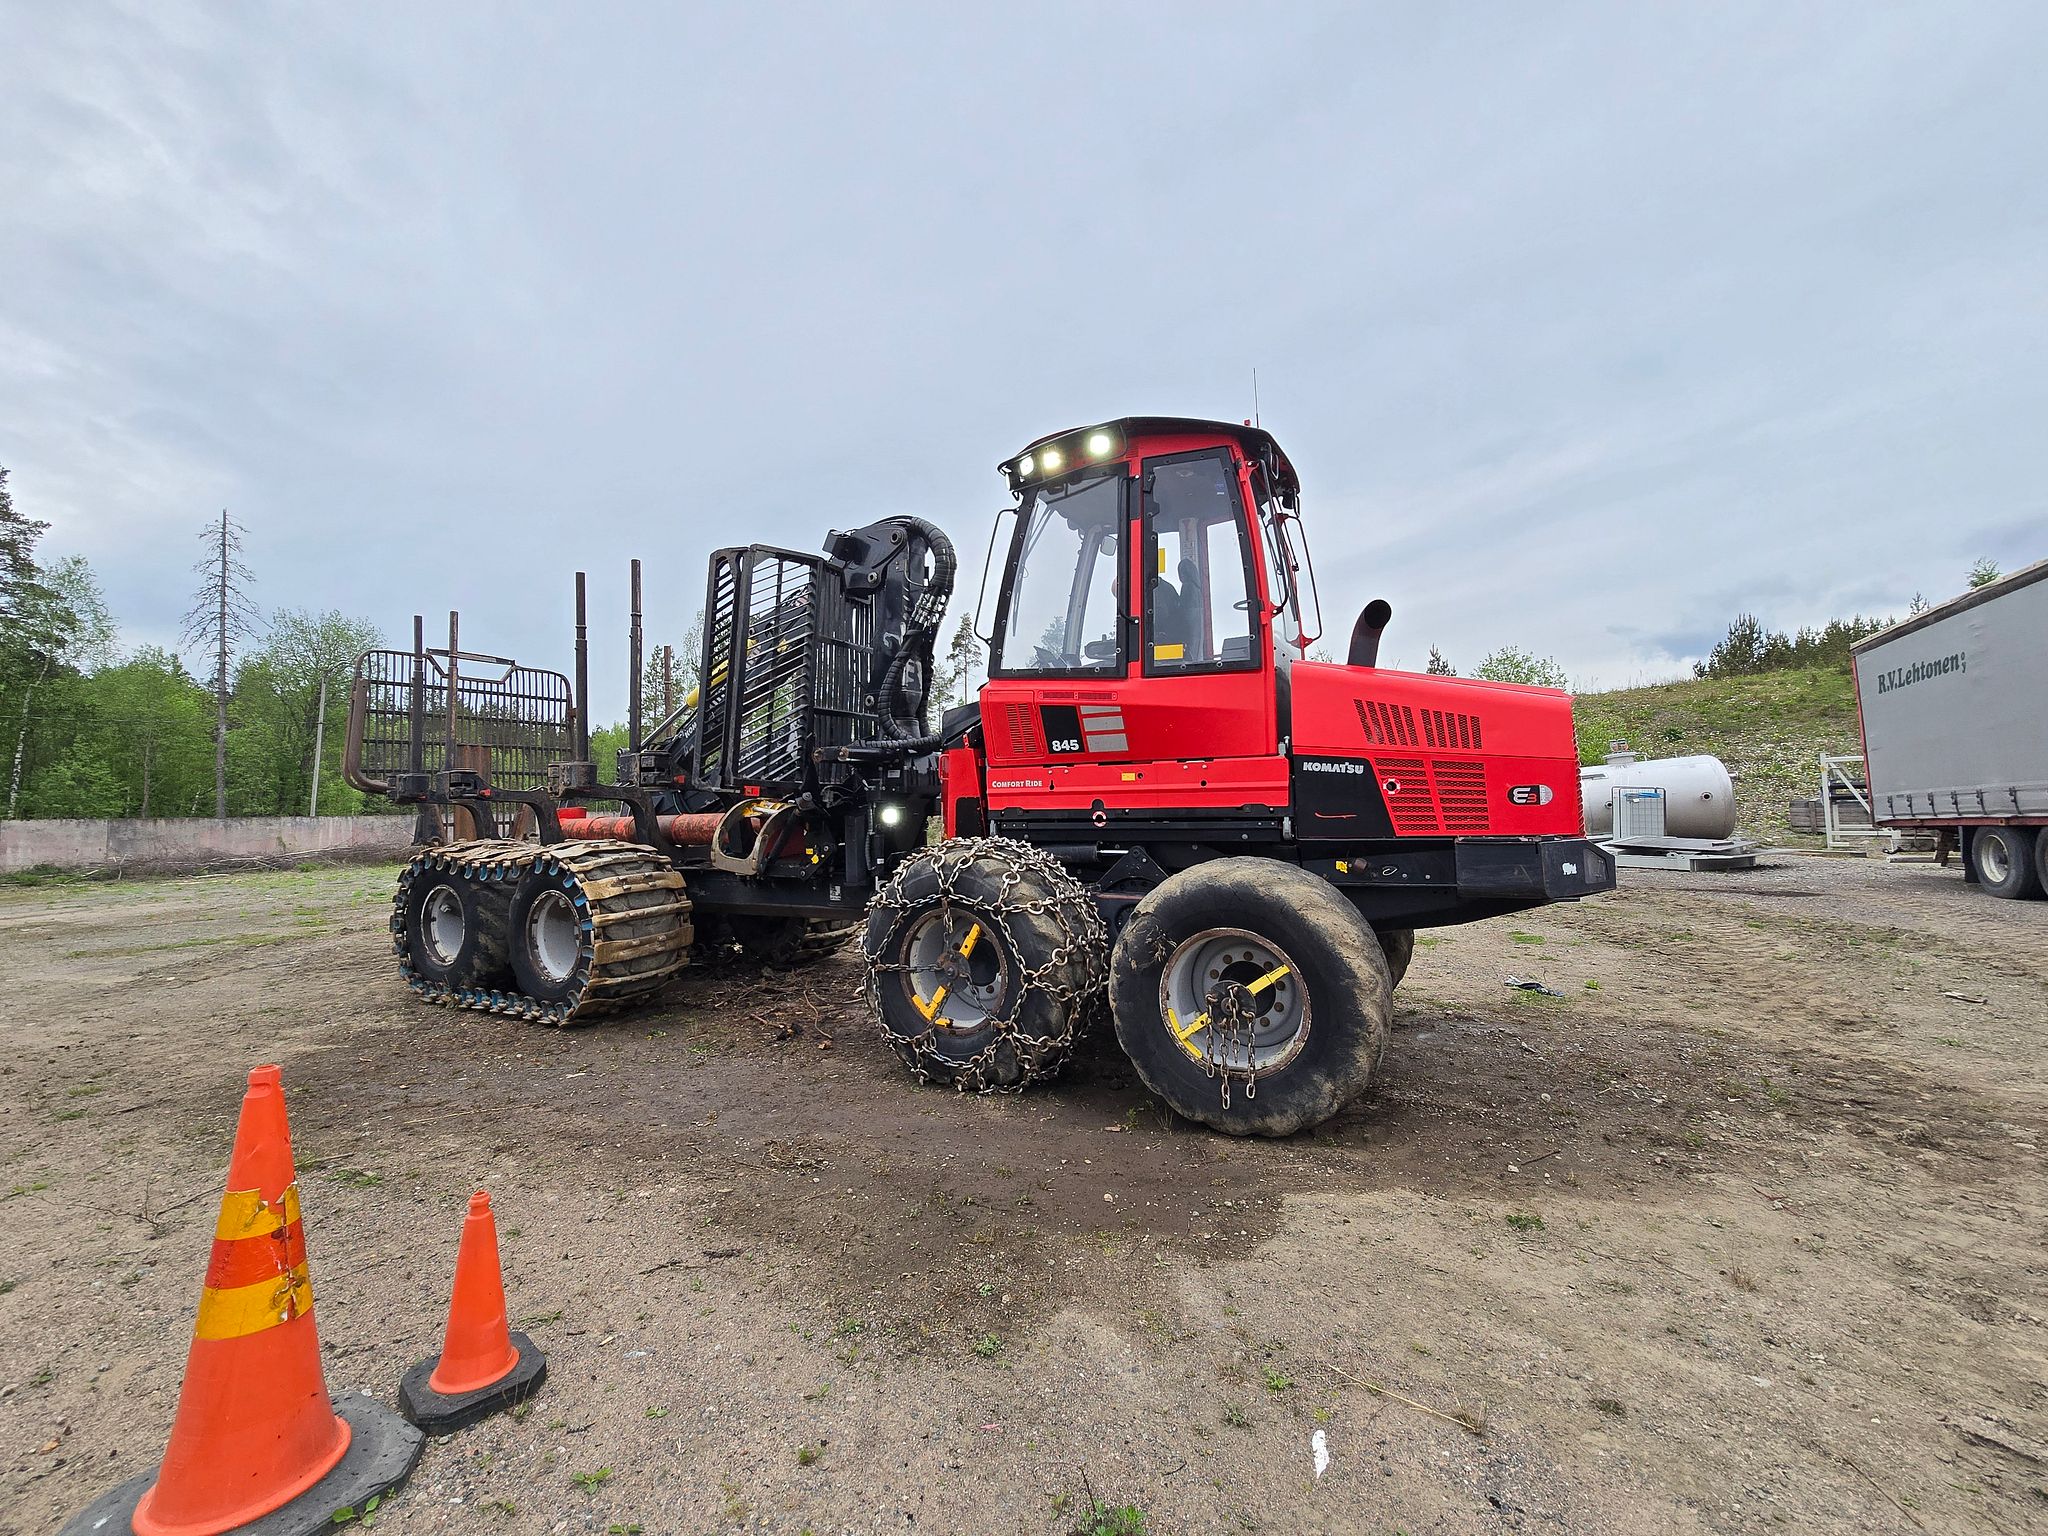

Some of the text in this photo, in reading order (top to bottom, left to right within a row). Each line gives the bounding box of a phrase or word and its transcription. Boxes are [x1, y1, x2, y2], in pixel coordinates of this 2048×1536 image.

[1877, 653, 1960, 695] R.V.Lehtonen
[1051, 739, 1080, 752] 845
[1302, 761, 1365, 775] KOMATSU
